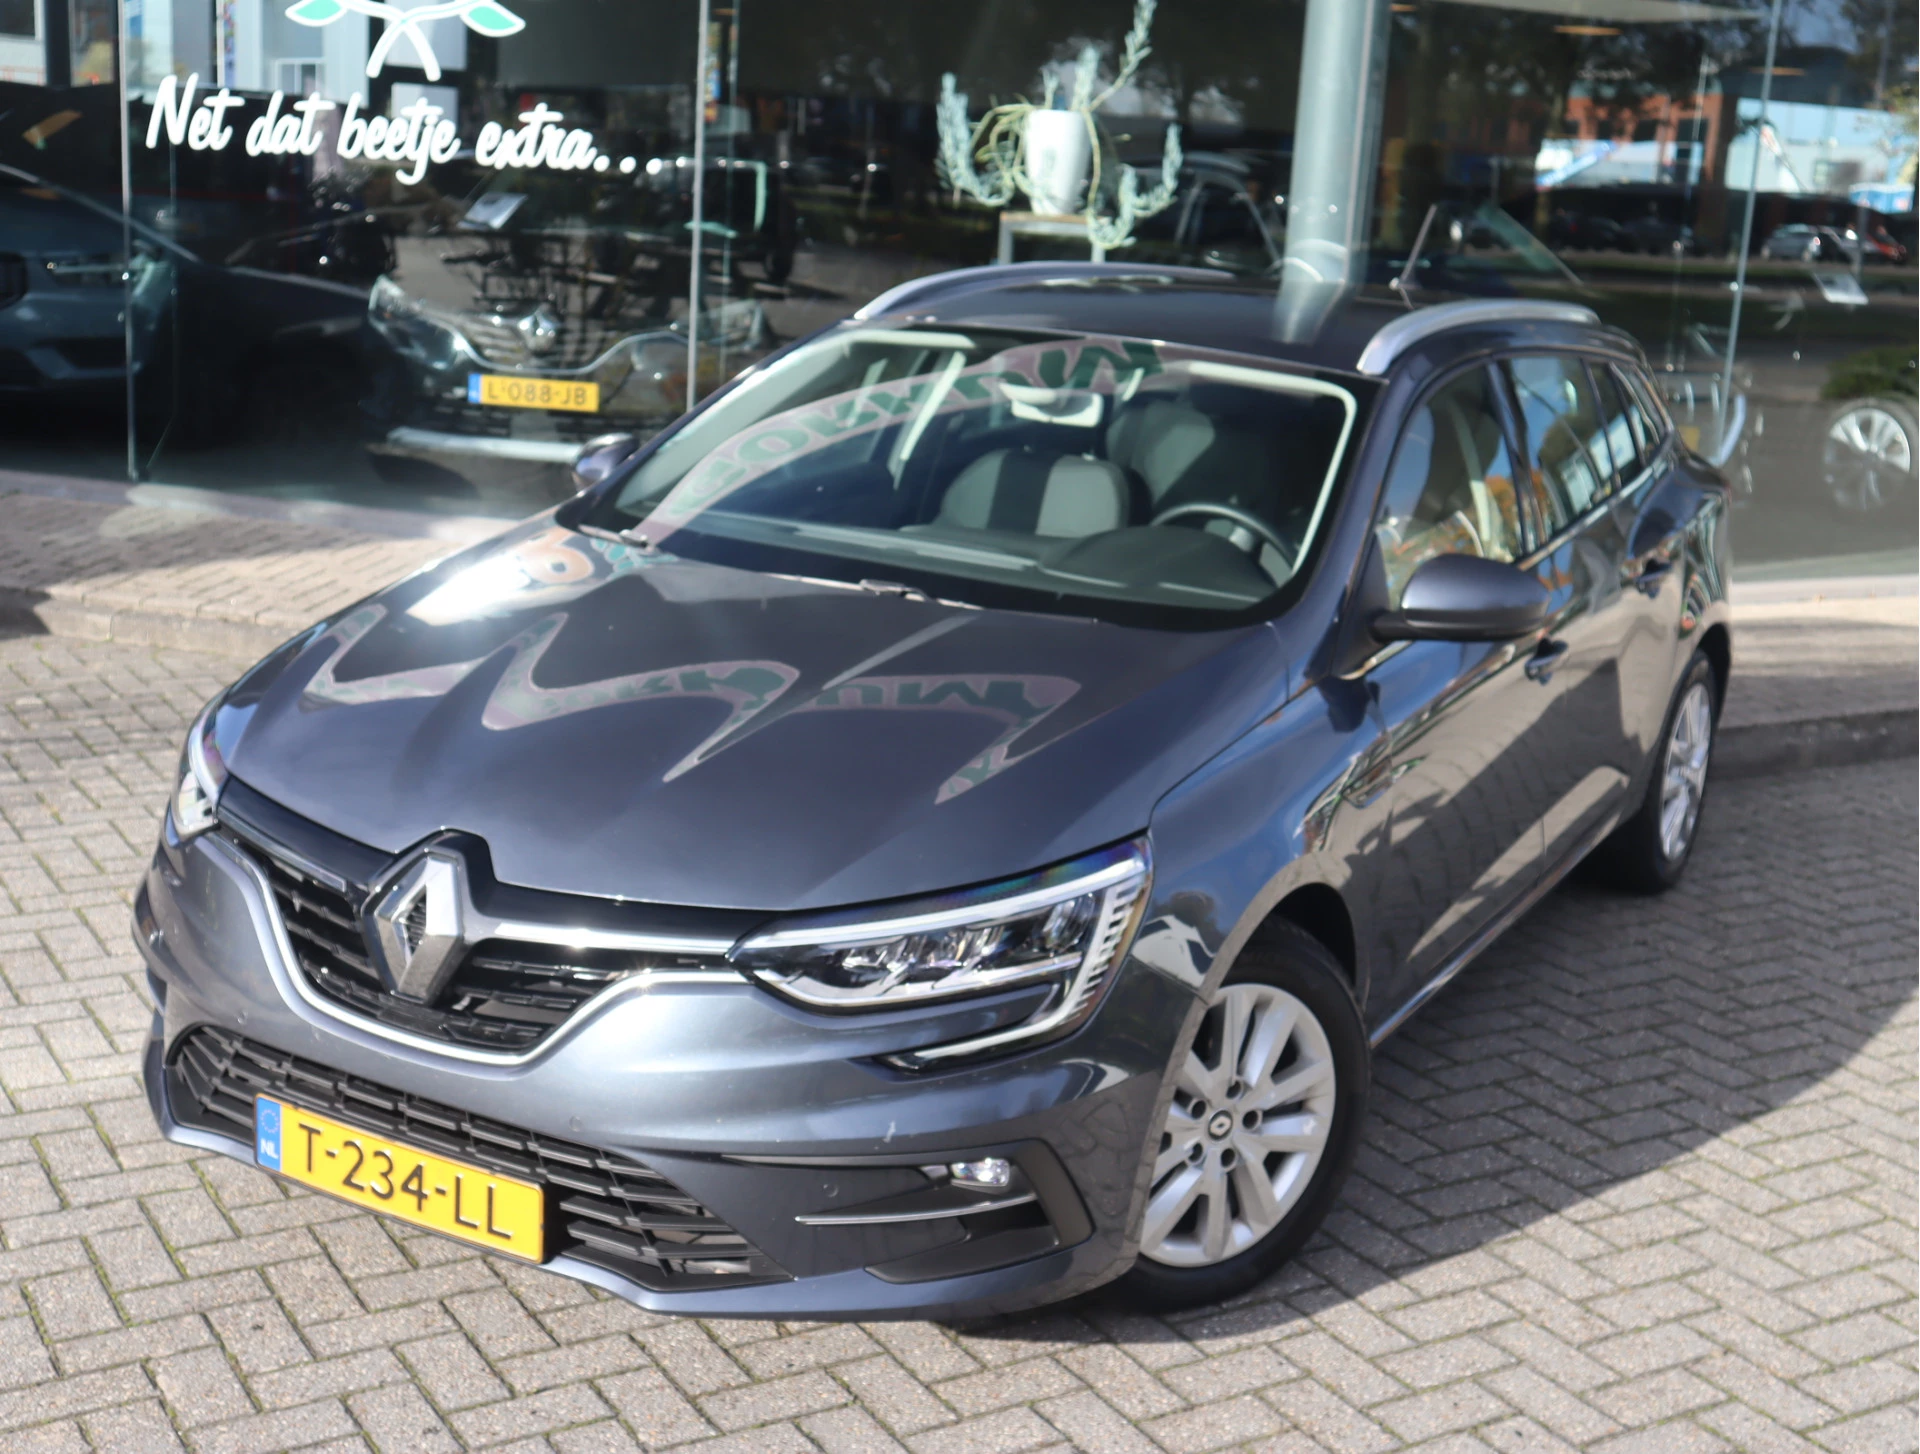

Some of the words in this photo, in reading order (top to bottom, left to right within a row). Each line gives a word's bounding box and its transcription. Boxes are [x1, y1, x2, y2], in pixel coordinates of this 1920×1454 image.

[145, 72, 245, 151] Net
[245, 90, 336, 157] dat
[336, 91, 461, 185] beetje
[260, 1138, 280, 1160] NL
[298, 1122, 512, 1241] T-234-LL
